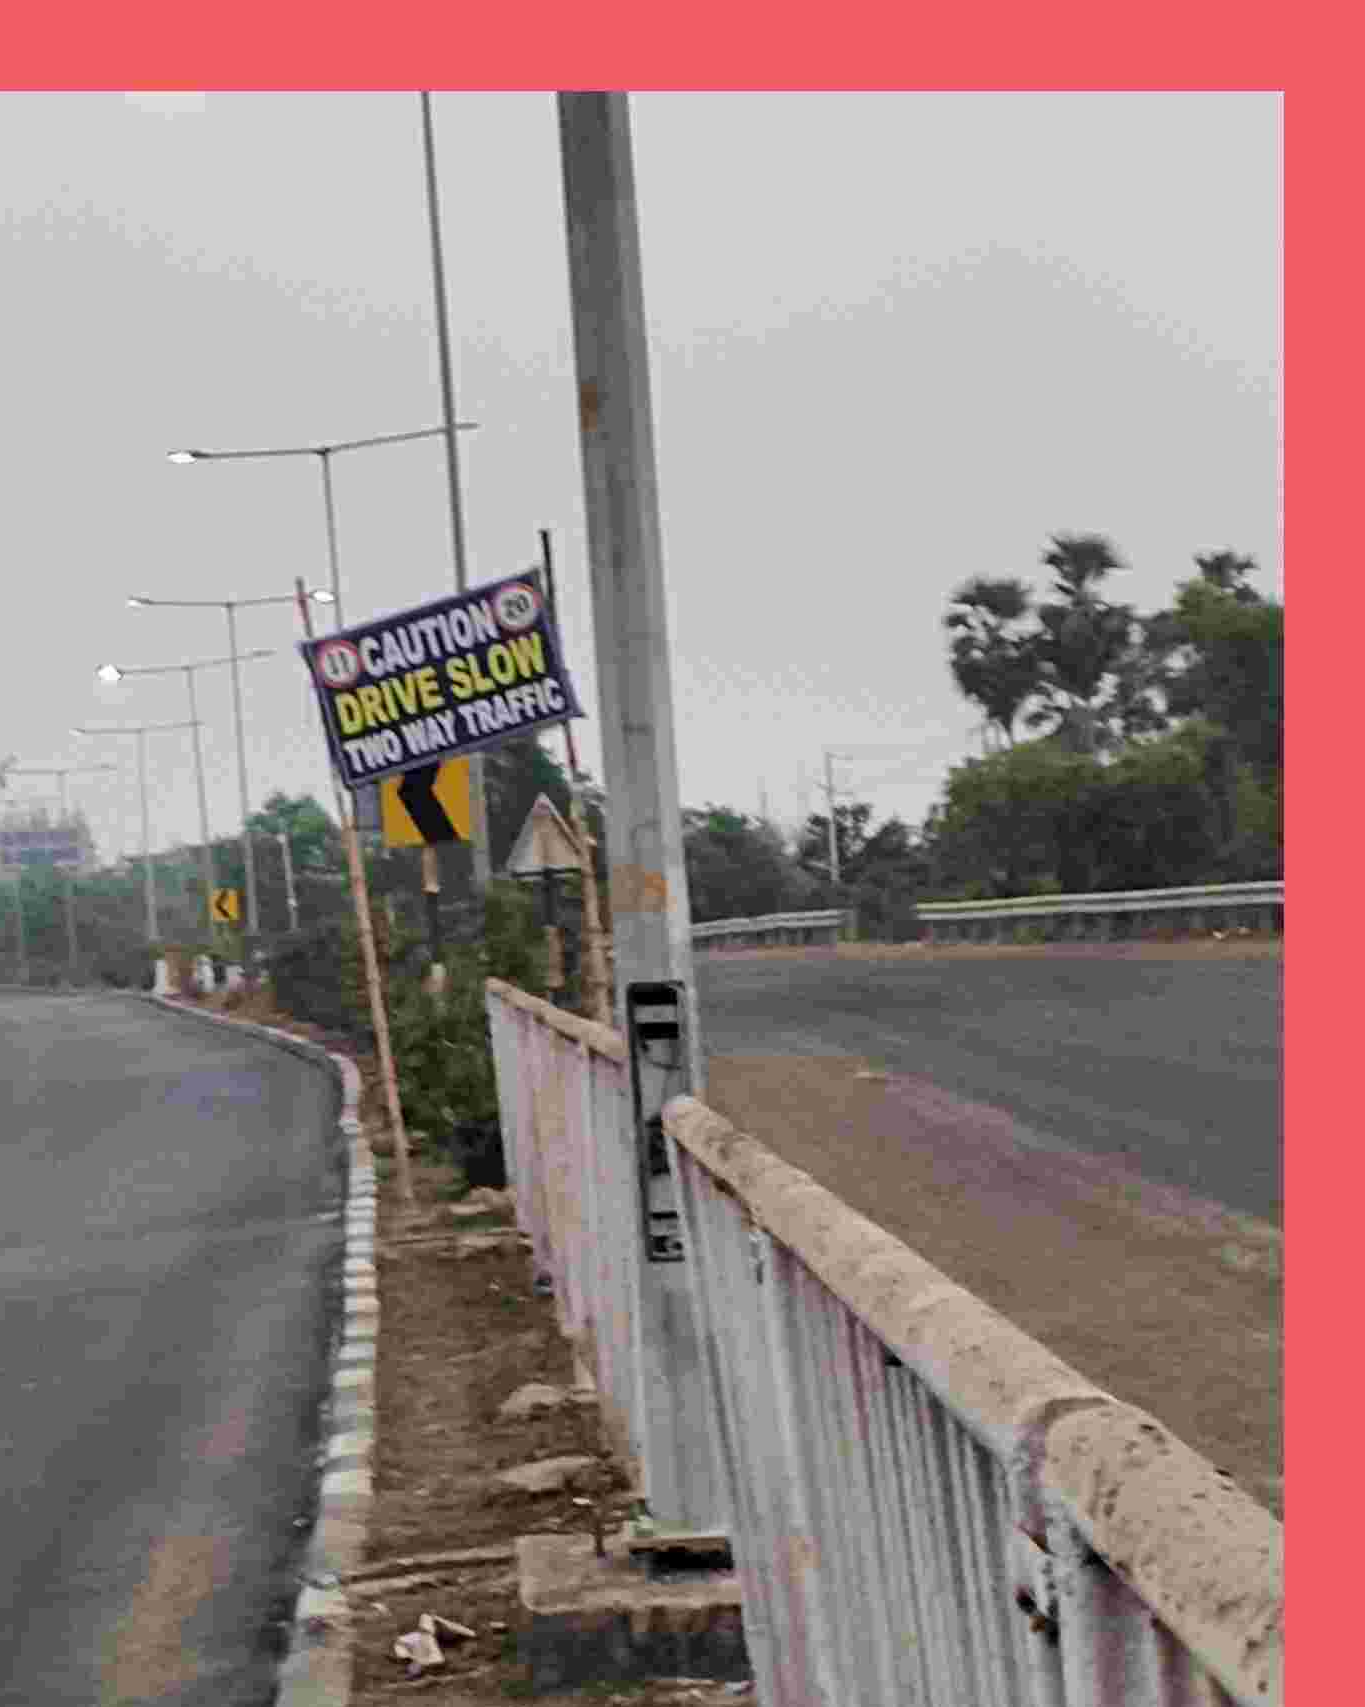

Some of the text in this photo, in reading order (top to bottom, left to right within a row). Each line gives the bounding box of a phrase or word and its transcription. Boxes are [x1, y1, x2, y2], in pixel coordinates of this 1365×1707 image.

[335, 631, 546, 735] DRIVE SLOW
[358, 599, 499, 677] CAUTION
[343, 677, 565, 773] TWO WAY TRAFFIC
